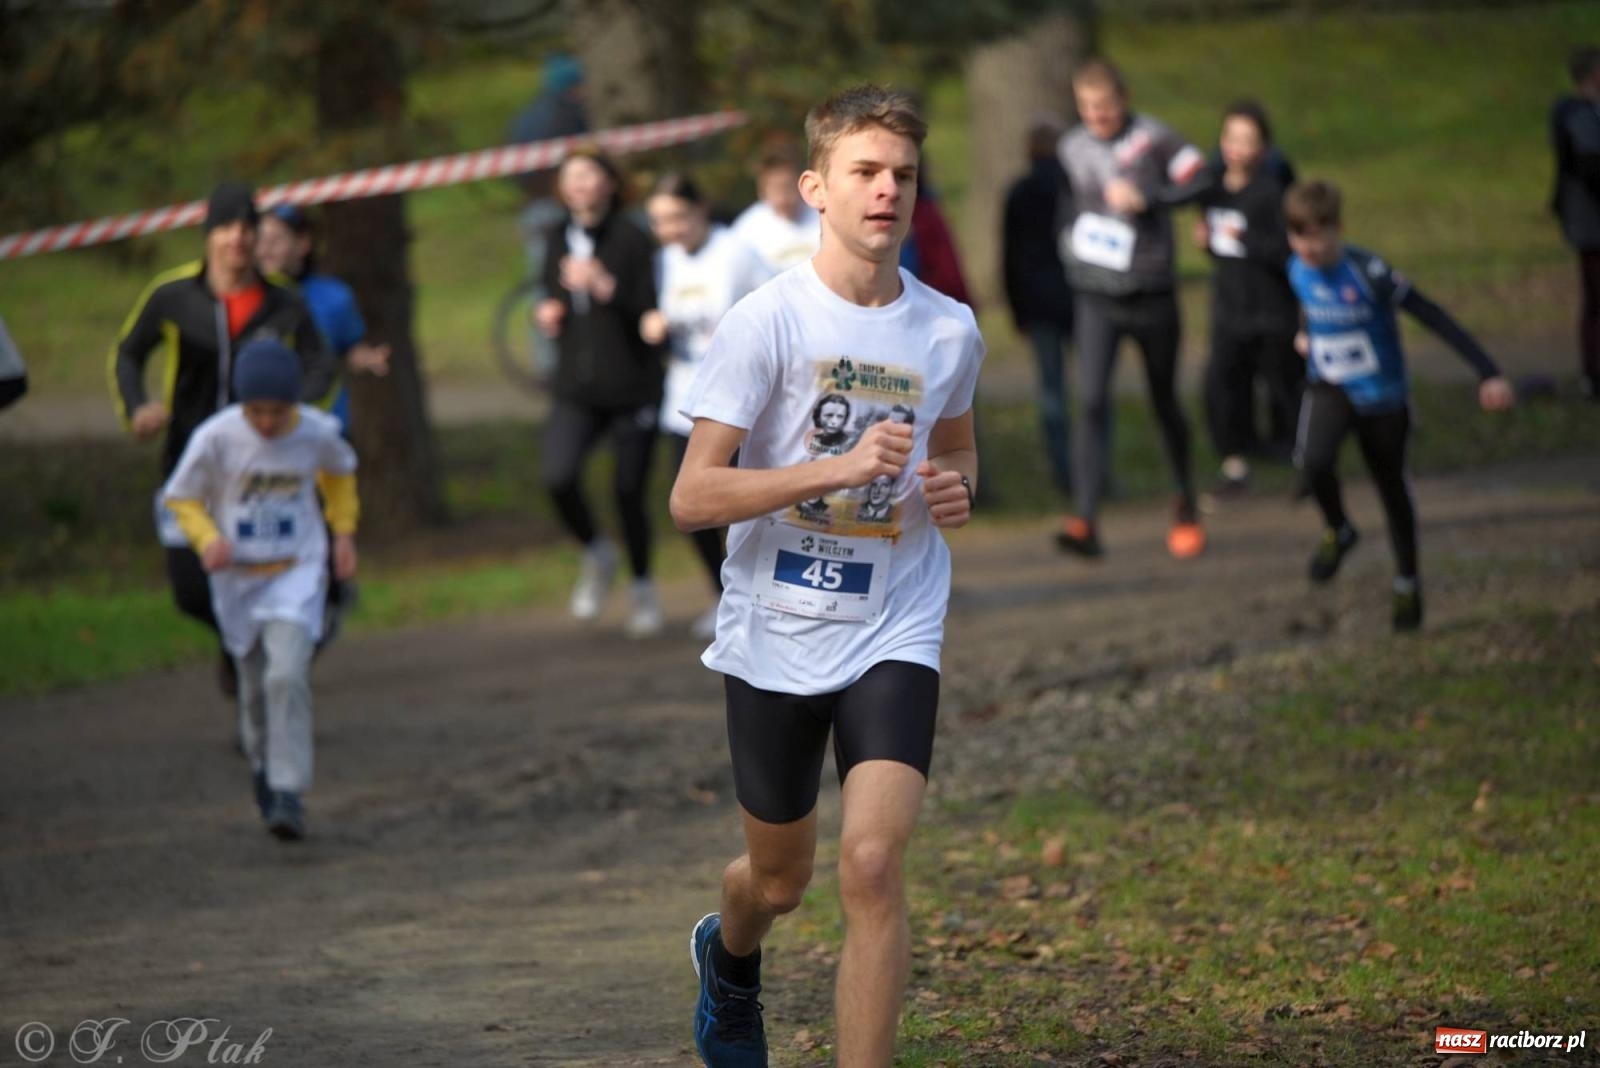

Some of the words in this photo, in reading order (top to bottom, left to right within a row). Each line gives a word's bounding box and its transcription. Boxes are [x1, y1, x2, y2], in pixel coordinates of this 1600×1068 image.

[860, 373, 911, 393] WILCZYM
[818, 543, 855, 557] WILCZYM
[801, 559, 843, 590] 45
